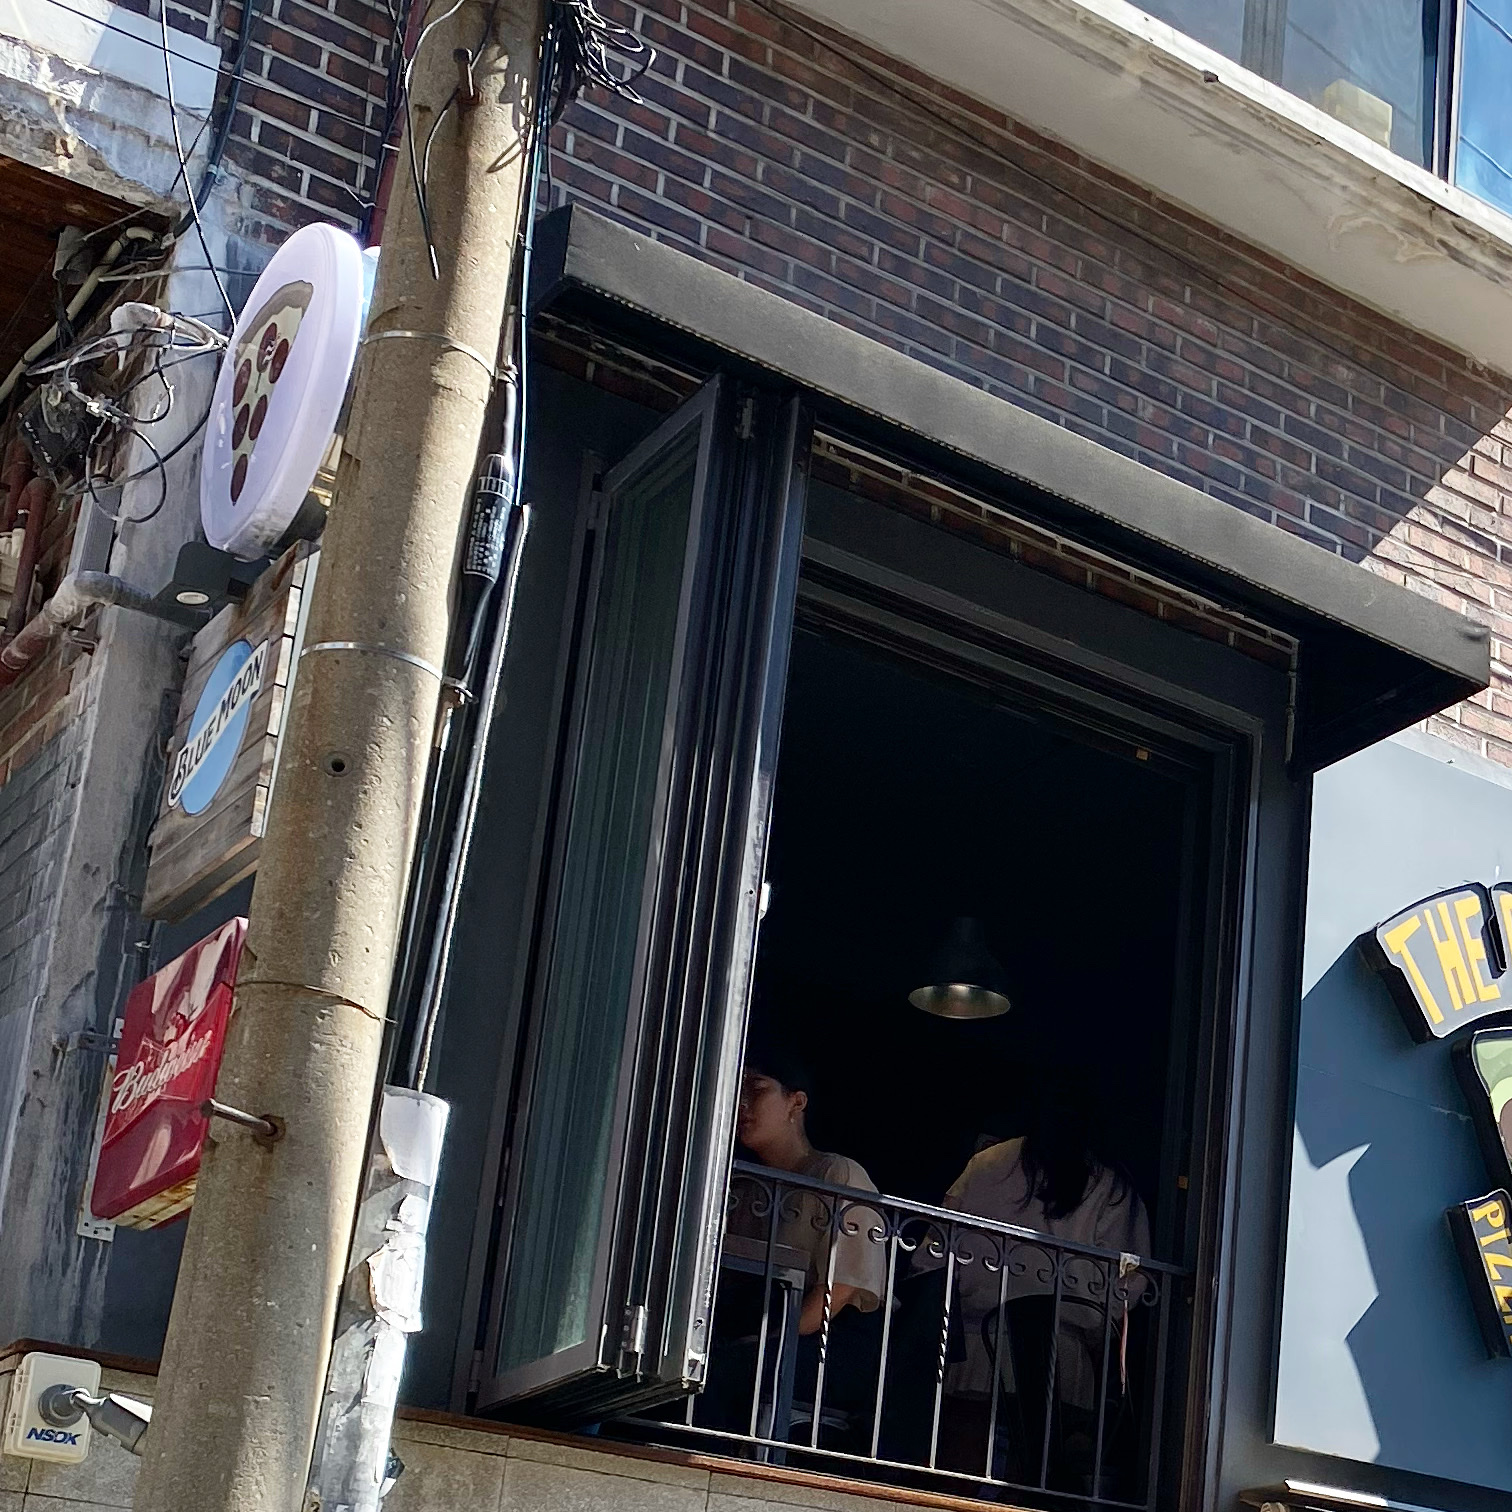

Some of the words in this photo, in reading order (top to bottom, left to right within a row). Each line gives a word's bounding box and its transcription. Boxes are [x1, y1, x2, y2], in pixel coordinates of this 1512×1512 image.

[170, 716, 217, 799] BLUE
[216, 650, 263, 734] MOON
[1384, 896, 1500, 1024] THE
